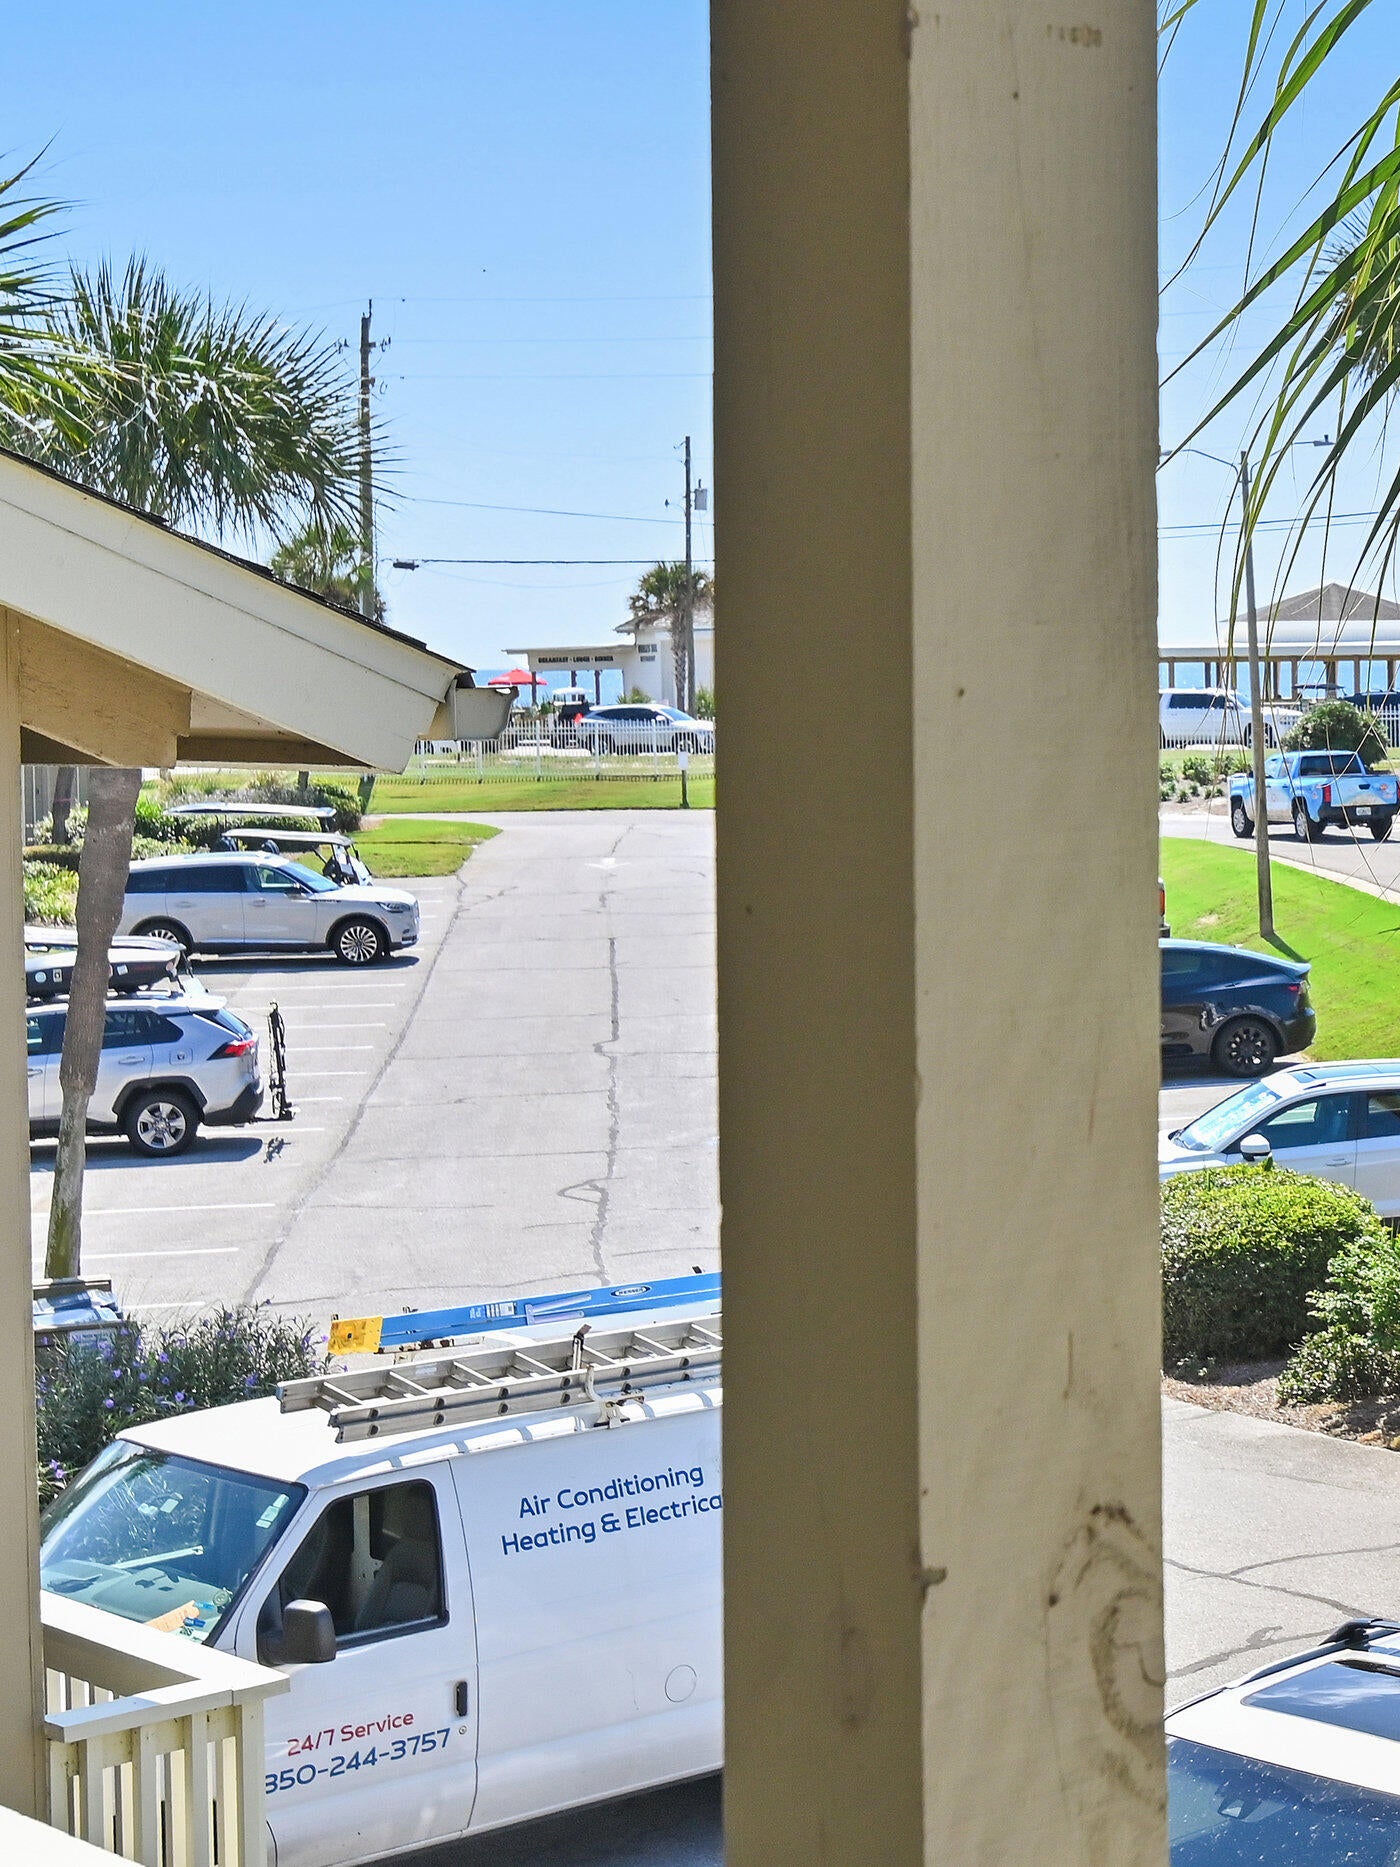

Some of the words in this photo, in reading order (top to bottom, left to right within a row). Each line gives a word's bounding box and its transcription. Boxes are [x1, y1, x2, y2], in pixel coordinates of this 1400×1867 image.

[519, 1494, 551, 1519] Air
[556, 1466, 705, 1510] Conditioning
[501, 1522, 597, 1556] Heating
[600, 1512, 622, 1534] &
[287, 1728, 335, 1757] 24/7
[340, 1712, 415, 1743] Service
